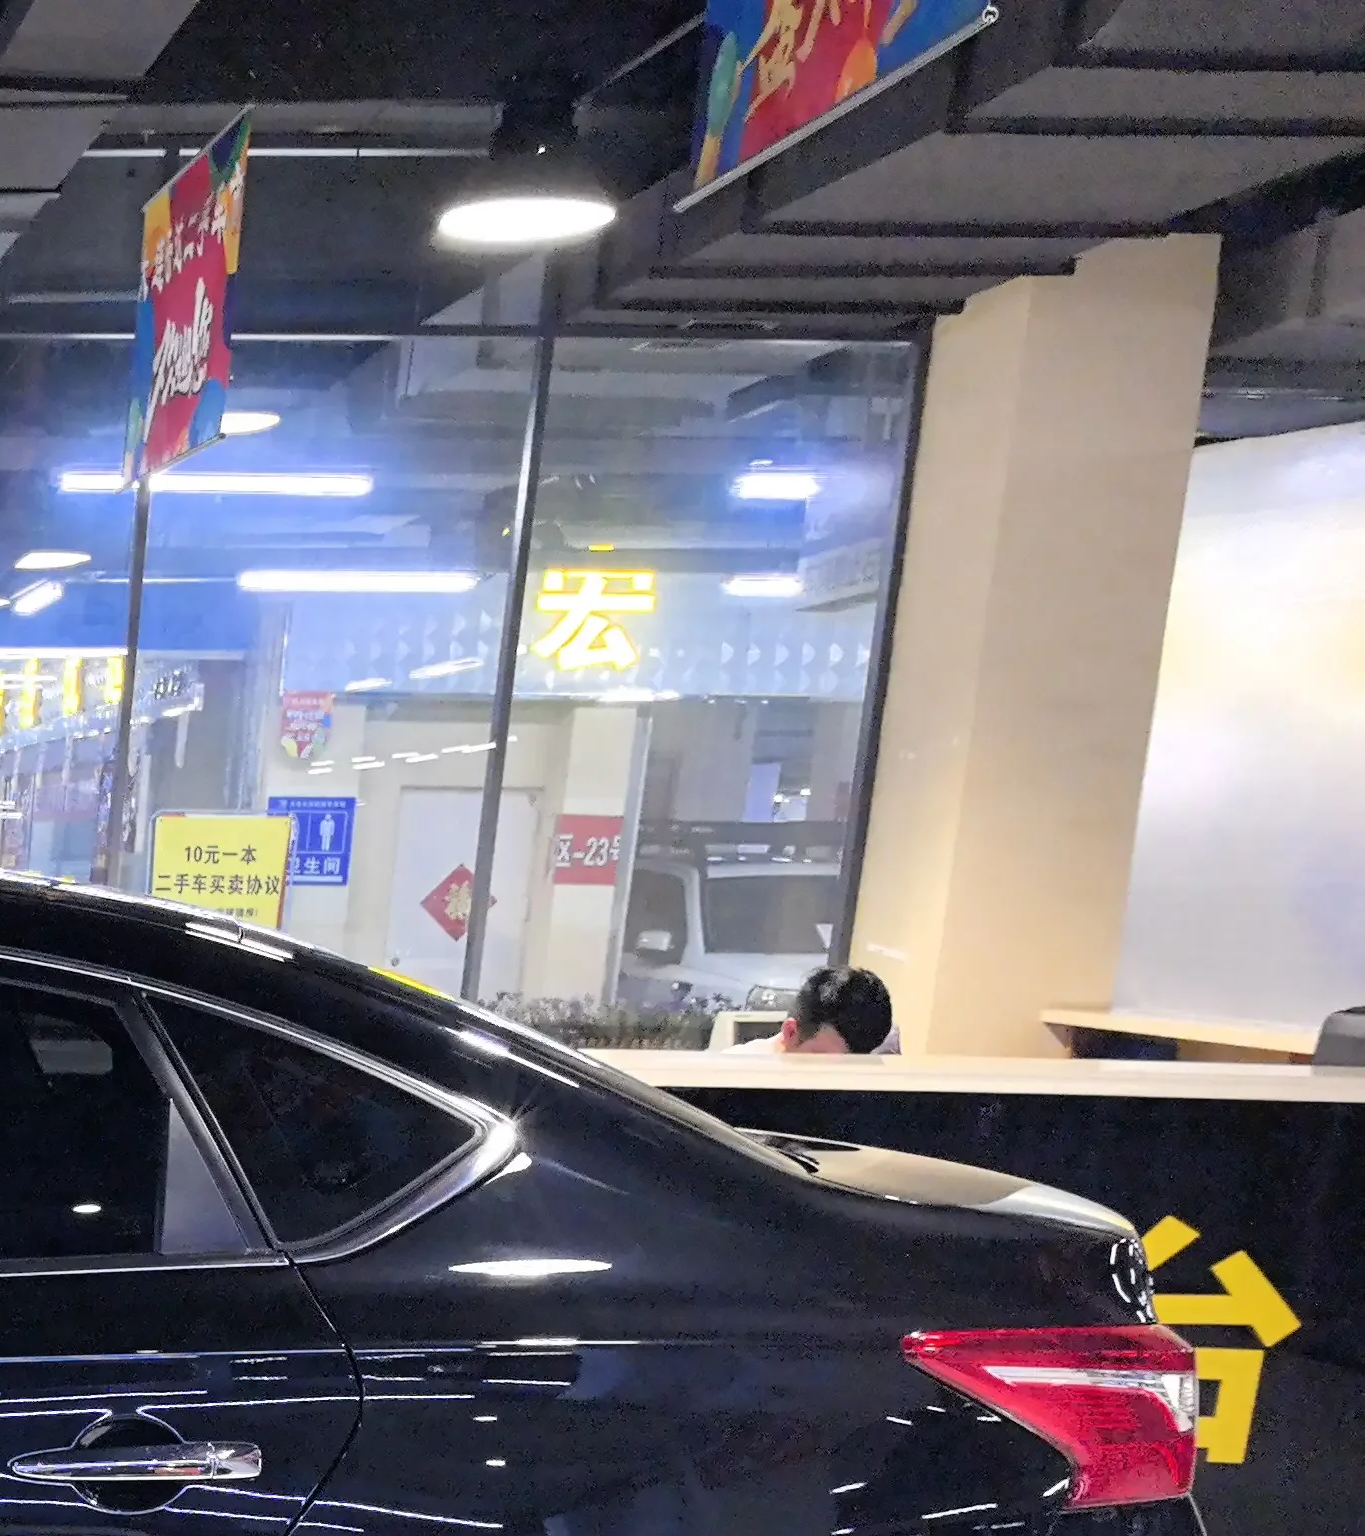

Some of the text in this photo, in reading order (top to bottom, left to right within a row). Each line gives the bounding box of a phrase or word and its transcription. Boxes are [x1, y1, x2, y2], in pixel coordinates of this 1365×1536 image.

[184, 844, 258, 866] 10元一本
[154, 873, 281, 896] 二手车买卖协议
